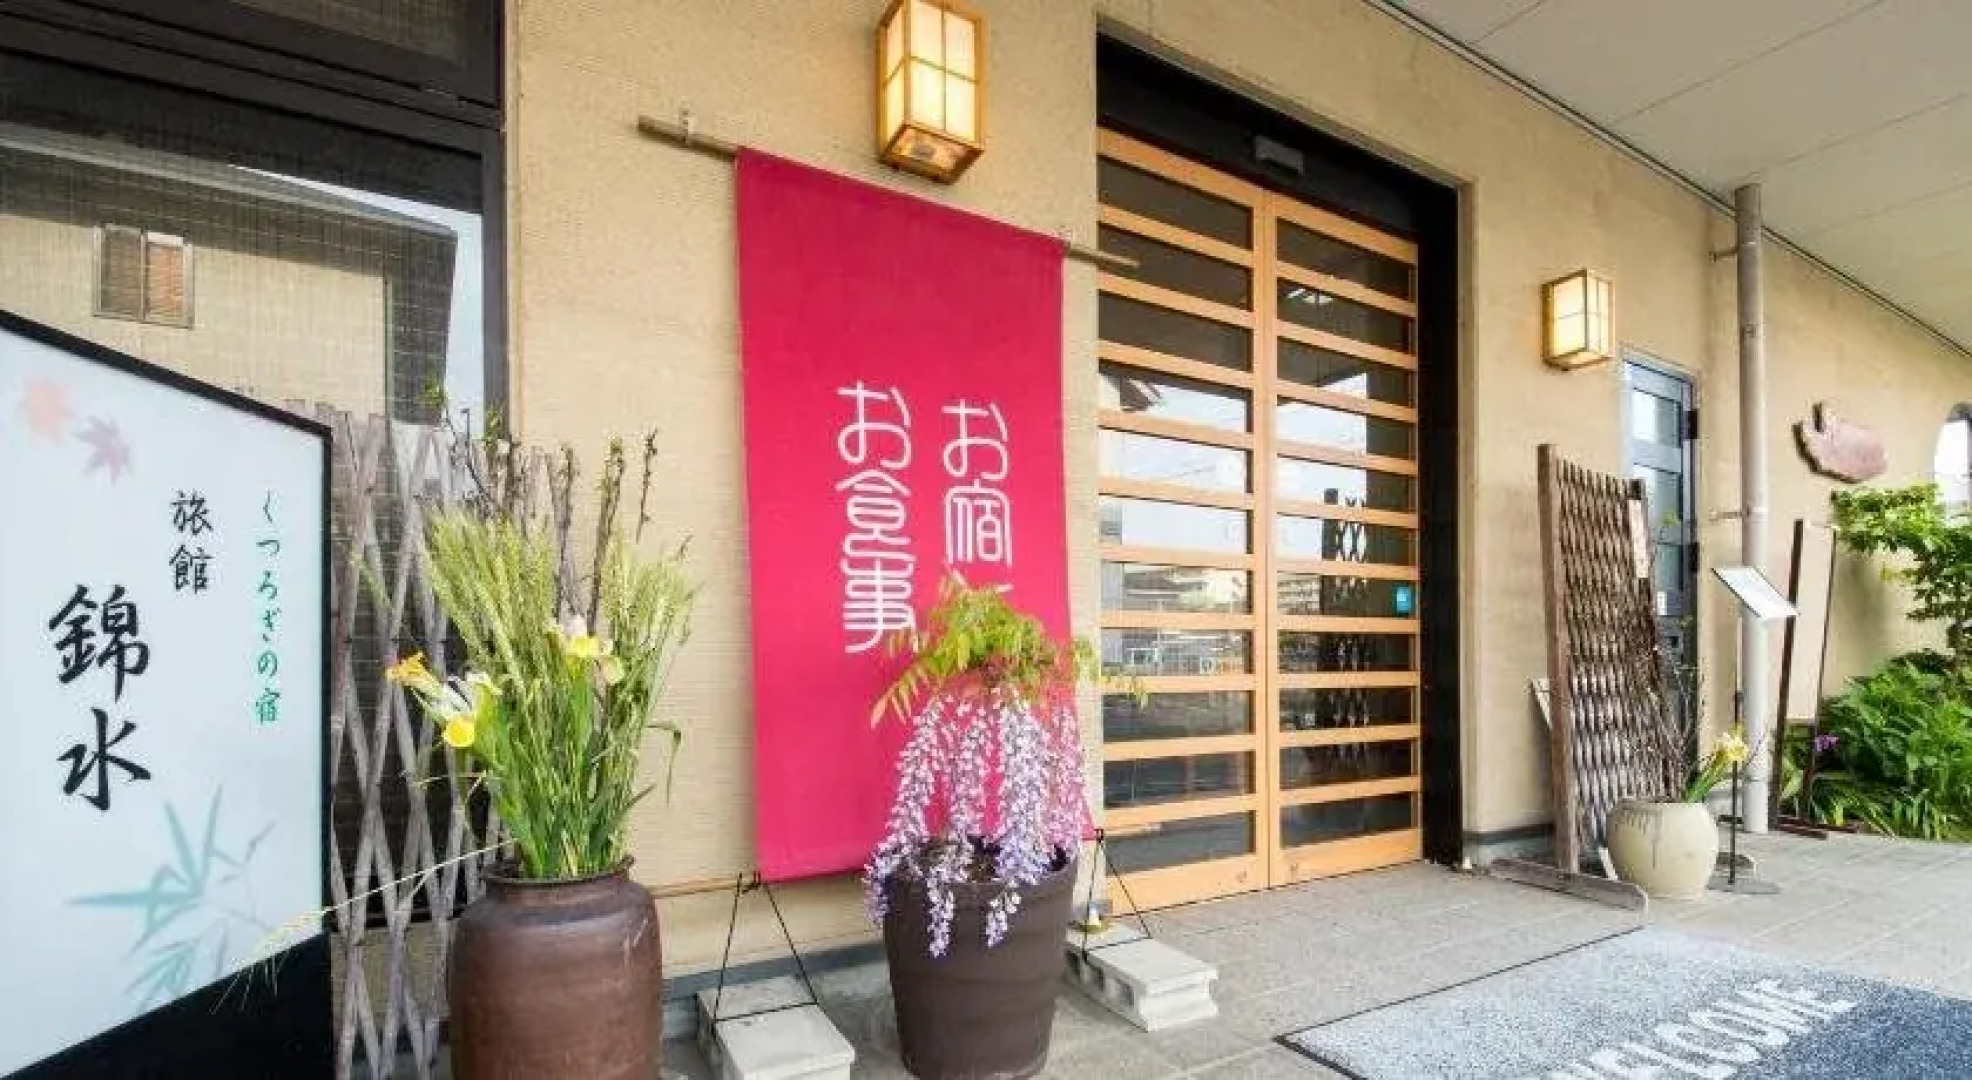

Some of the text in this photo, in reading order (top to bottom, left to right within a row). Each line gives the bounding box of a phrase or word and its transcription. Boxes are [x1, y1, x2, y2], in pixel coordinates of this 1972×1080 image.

[168, 488, 214, 595] 旅館
[836, 380, 917, 654] お食事
[941, 398, 1014, 593] お宿
[47, 583, 152, 813] 錦水
[255, 487, 282, 724] くつろぎの宿
[1546, 978, 1857, 1080] ELCOME
